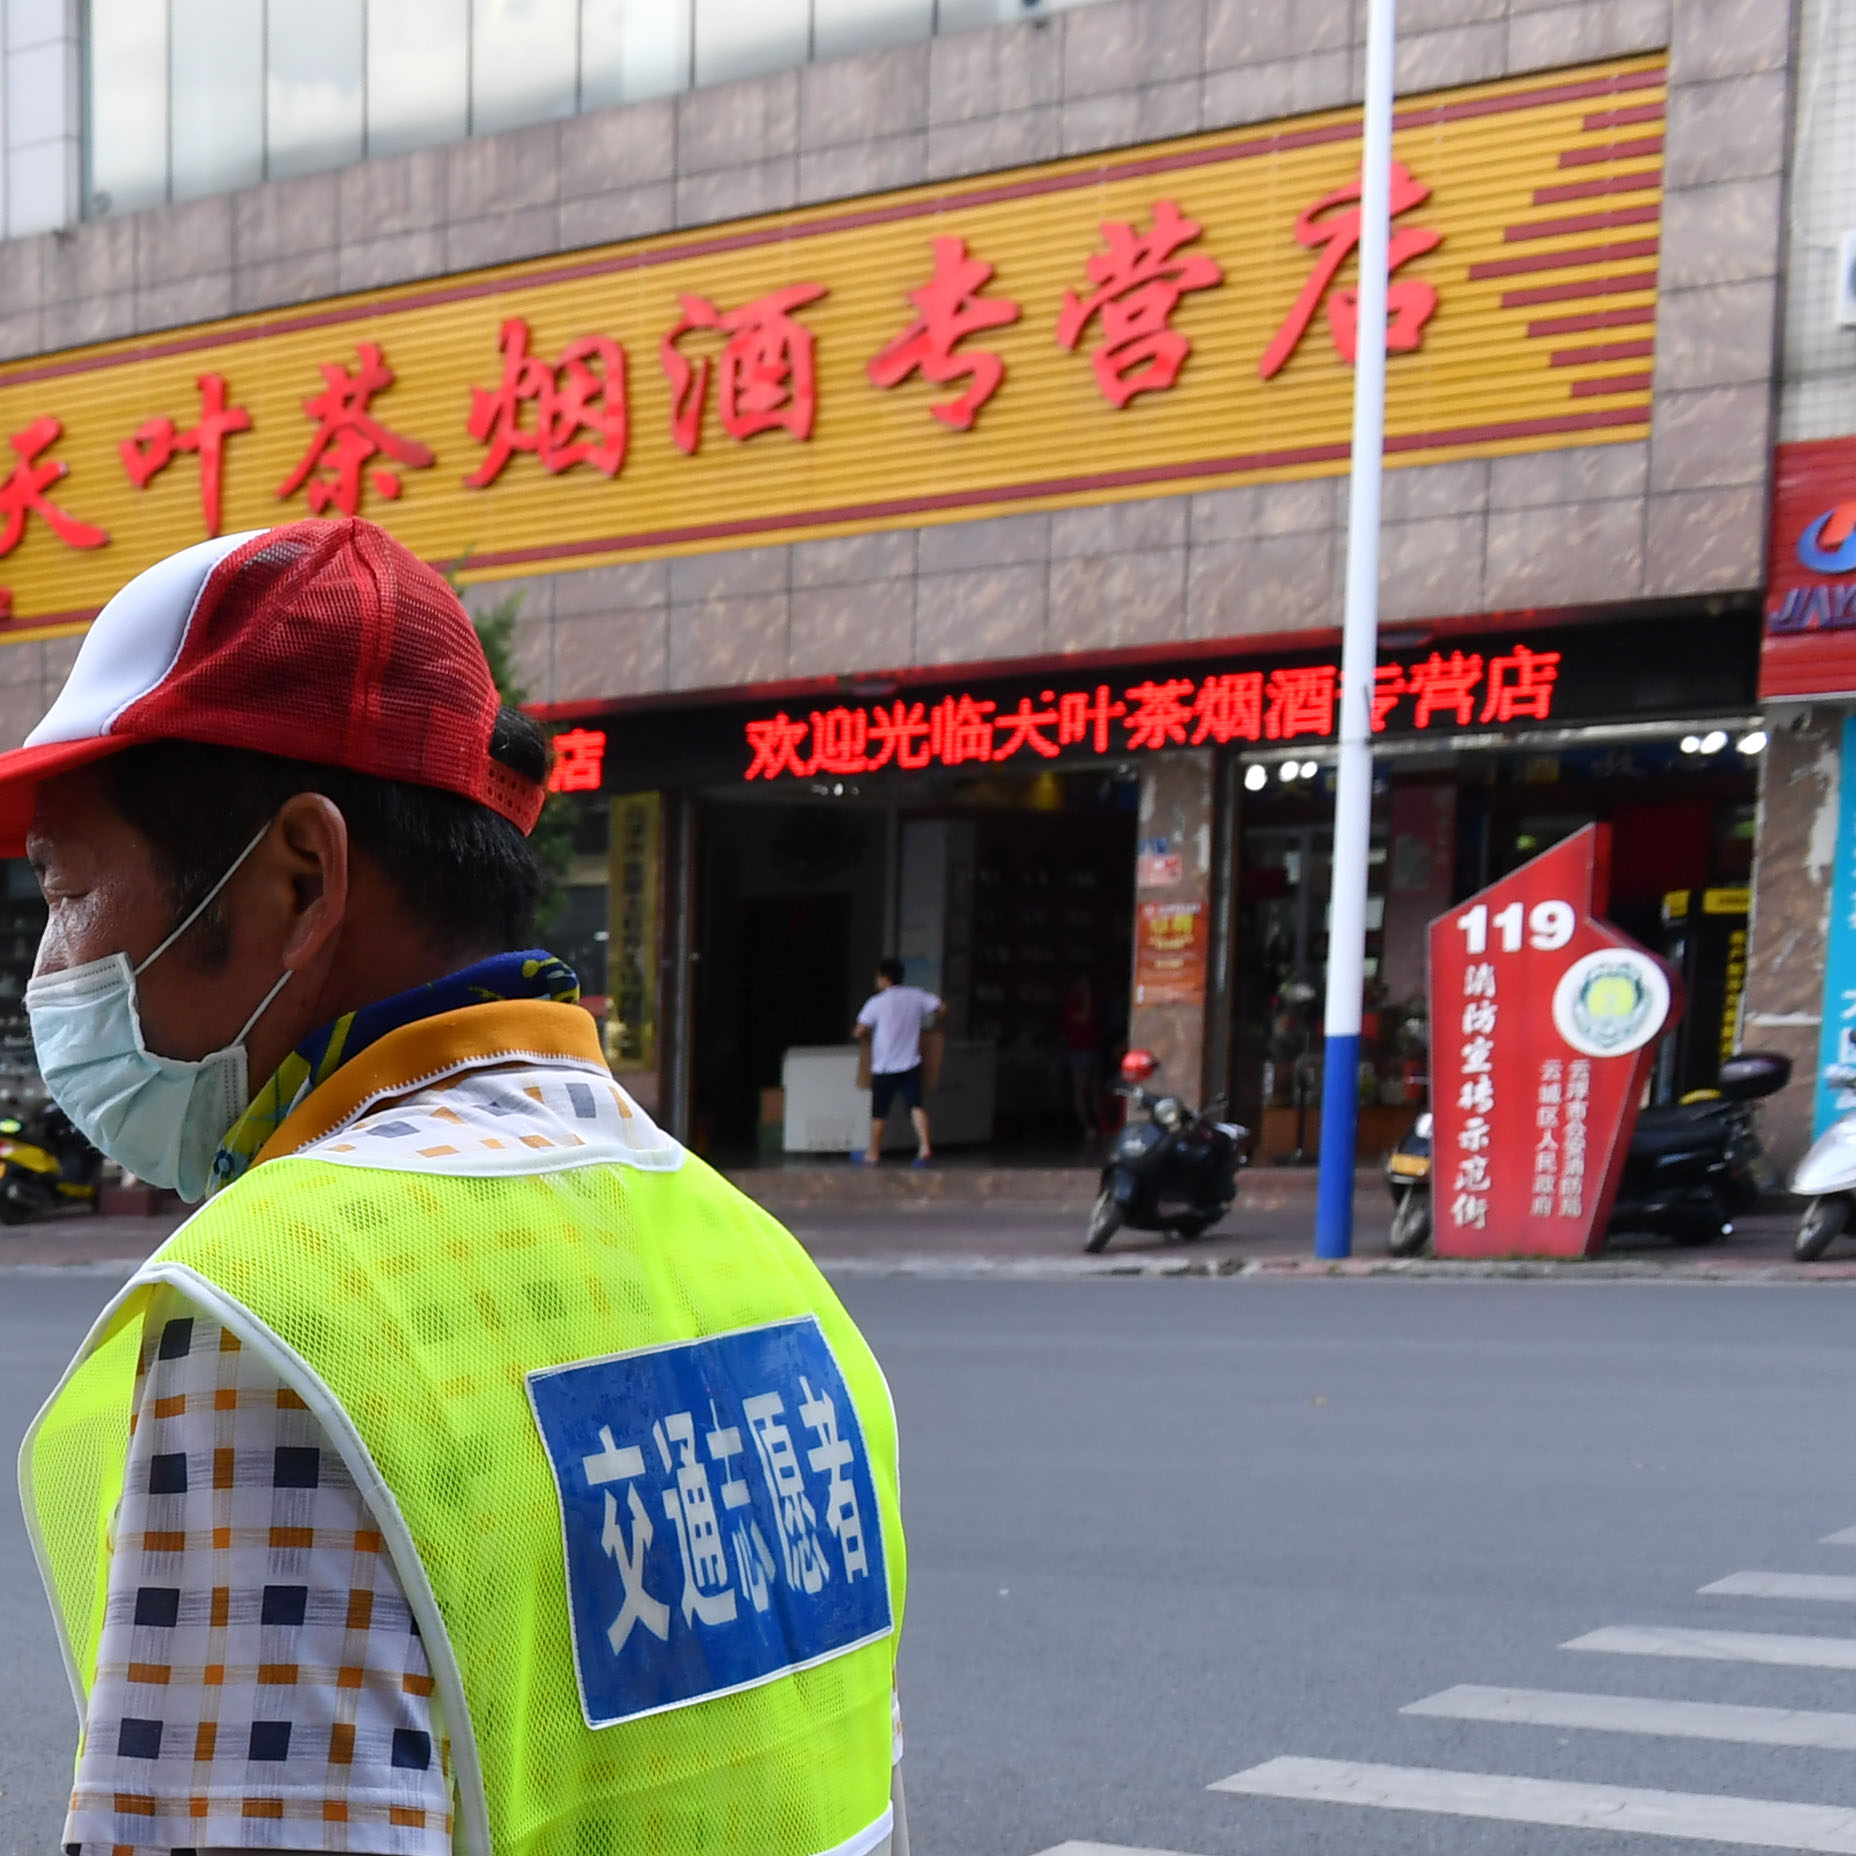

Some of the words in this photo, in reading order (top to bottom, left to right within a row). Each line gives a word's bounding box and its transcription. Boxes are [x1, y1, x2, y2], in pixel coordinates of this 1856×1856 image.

[1457, 900, 1575, 954] 119
[581, 1375, 871, 1657] 交通志愿者
